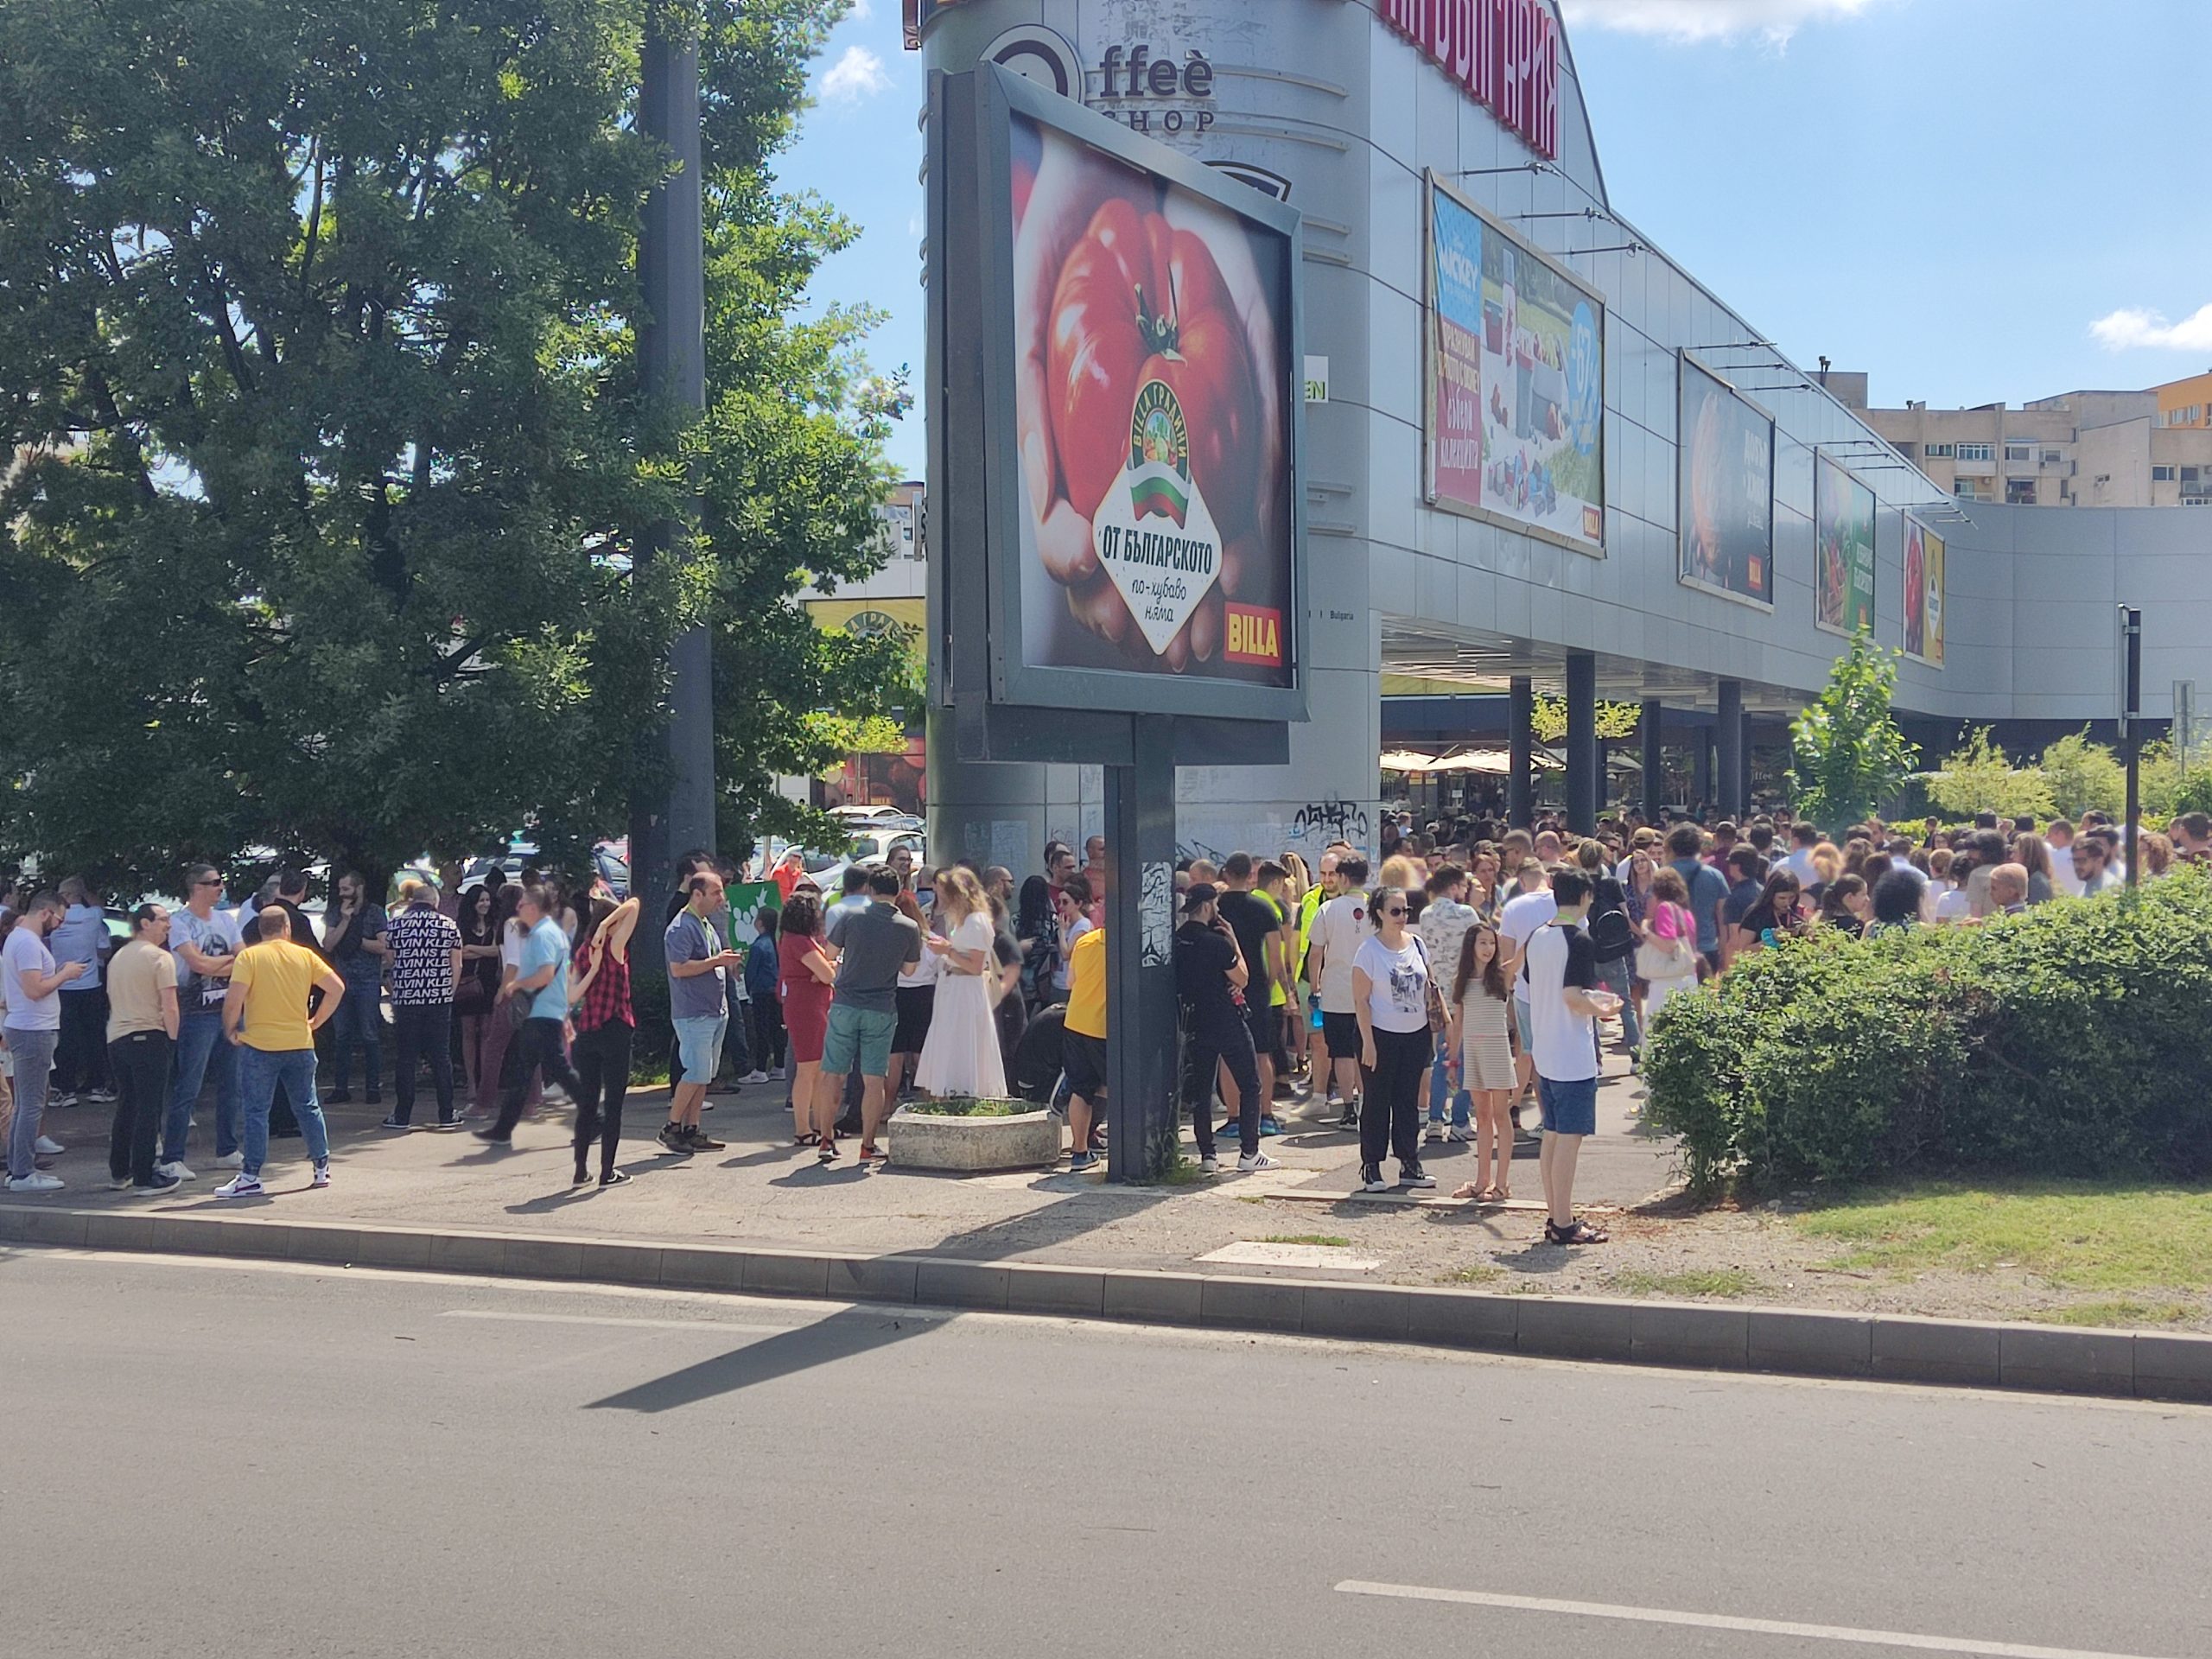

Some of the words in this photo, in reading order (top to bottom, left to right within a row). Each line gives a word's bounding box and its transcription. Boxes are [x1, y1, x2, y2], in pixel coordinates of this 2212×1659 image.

[1133, 391, 1152, 448] BILLA
[1153, 384, 1187, 458] ГРАДИНИ
[1103, 525, 1122, 560] ОТ
[1123, 527, 1212, 575] БЪЛГАРСКОТО
[1131, 576, 1187, 604] по-хубаво
[1144, 606, 1174, 623] няма
[1228, 613, 1279, 658] BILLA
[394, 927, 438, 939] JEANS
[396, 948, 437, 958] JEANS
[397, 967, 437, 978] JEANS
[398, 987, 440, 999] JEANS
